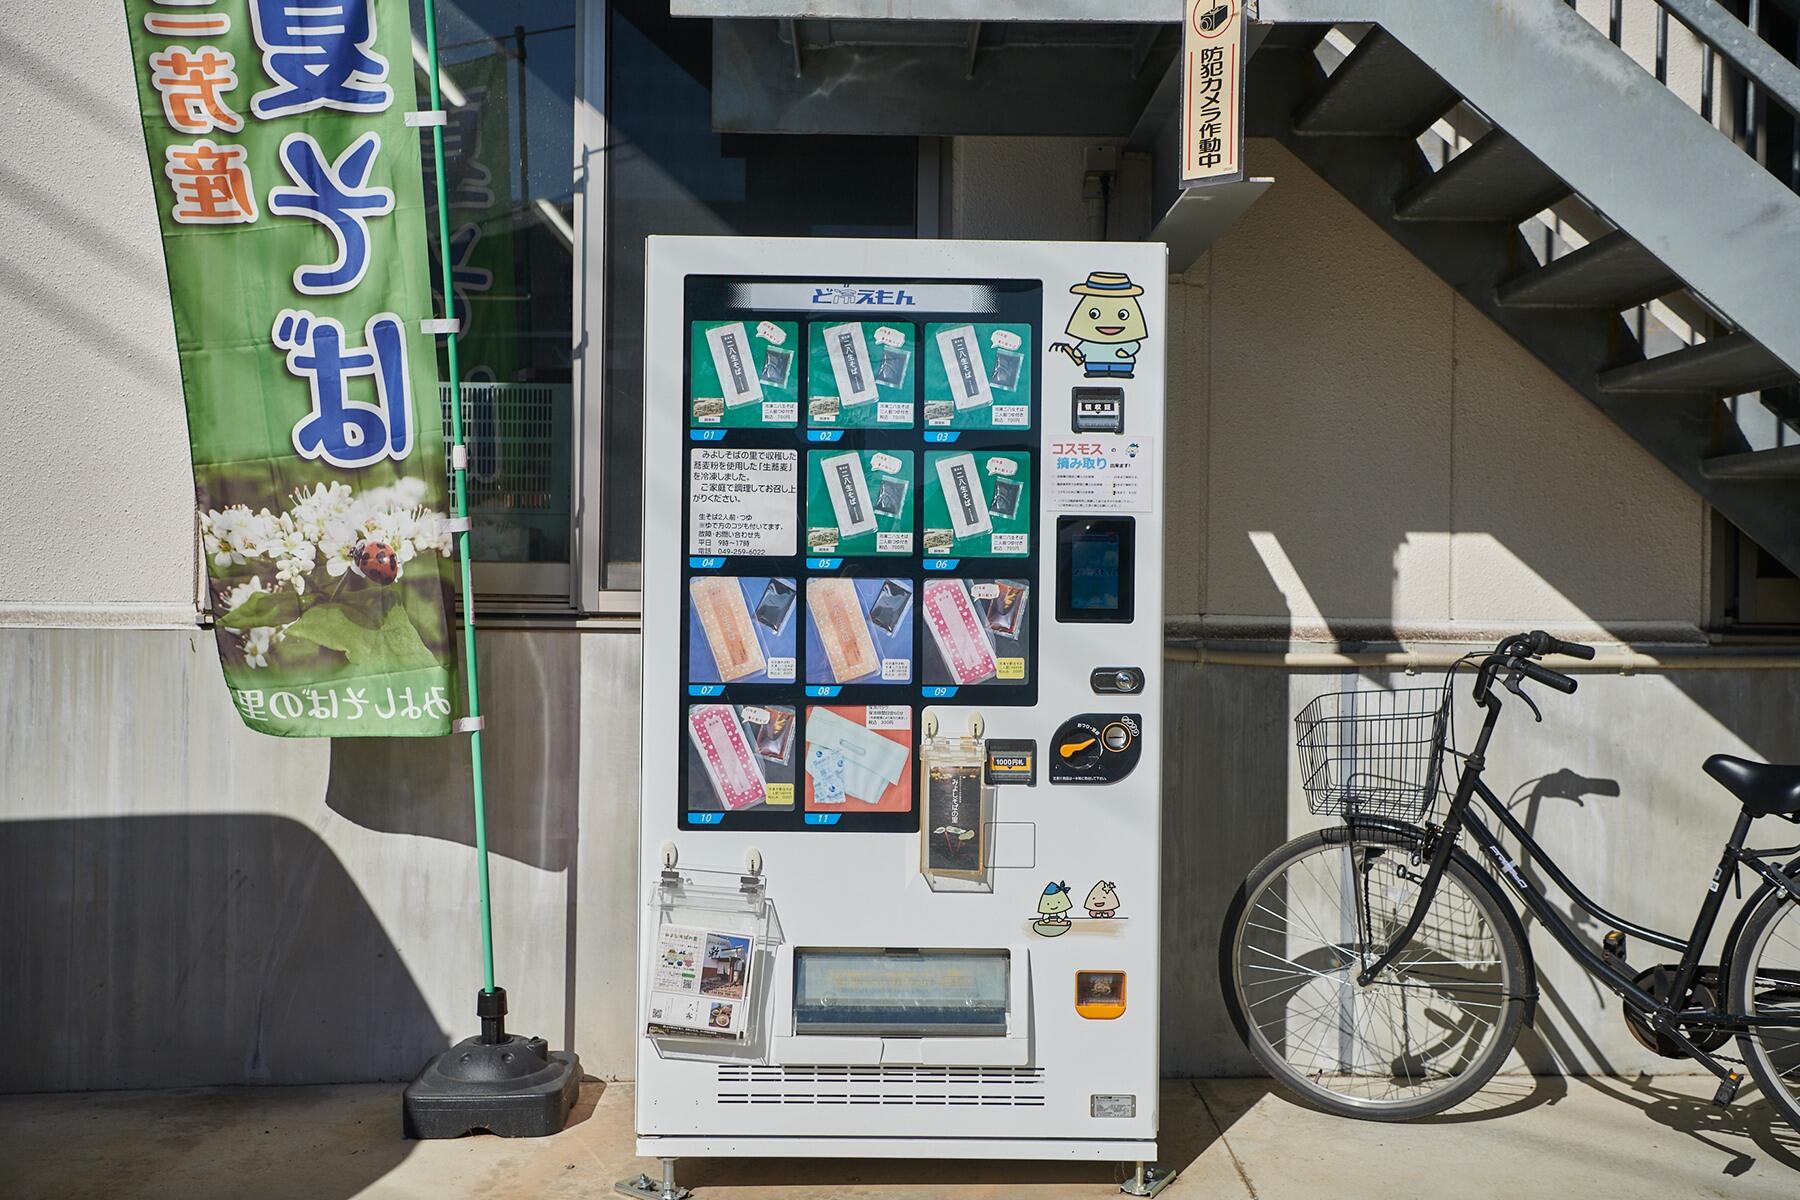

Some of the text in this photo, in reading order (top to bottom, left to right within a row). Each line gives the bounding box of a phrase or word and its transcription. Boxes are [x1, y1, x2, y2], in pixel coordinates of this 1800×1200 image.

[1198, 46, 1224, 168] 防犯カメラ作動中
[703, 431, 714, 439] 01
[820, 432, 832, 440] 02
[937, 433, 948, 441] 03
[1052, 443, 1102, 455] コスモス
[702, 450, 796, 460] みよしそばの里で収穫した
[694, 461, 792, 471] 蕎麦粉を使用した「生蕎麦」
[1057, 458, 1107, 469] 摘み取り
[694, 472, 749, 481] を冷凍しました。
[701, 483, 796, 494] ご家庭で調理してお召し上
[693, 494, 741, 503] がりください。
[702, 558, 714, 566] 04
[819, 560, 830, 568] 05
[936, 560, 947, 568] 06
[701, 686, 713, 694] 07
[818, 687, 830, 696] 08
[934, 688, 947, 696] 09
[701, 814, 712, 822] 10
[818, 815, 828, 823] 11
